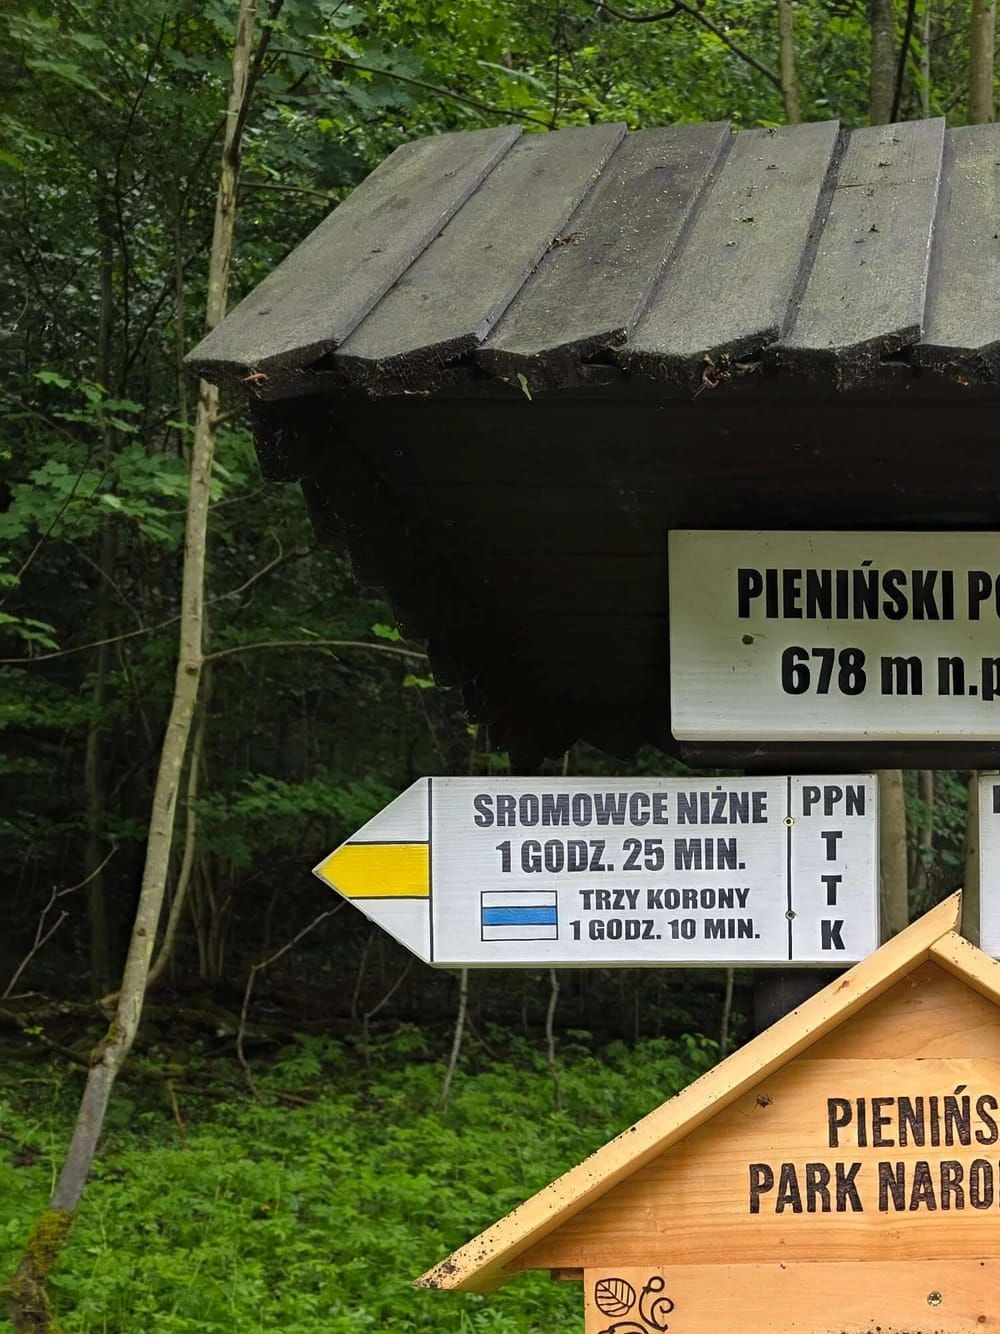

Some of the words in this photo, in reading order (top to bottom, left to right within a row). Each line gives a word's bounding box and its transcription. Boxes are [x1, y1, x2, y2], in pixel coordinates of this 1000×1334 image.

[738, 560, 954, 620] PIENIŃSKI
[782, 646, 866, 695] 678
[881, 656, 922, 695] m
[474, 792, 668, 827] SROMOWCE
[677, 786, 767, 824] NIŻNE
[803, 785, 865, 816] PPN
[496, 841, 511, 872] 1
[521, 839, 614, 873] GODZ.
[623, 838, 664, 871] 25
[675, 838, 745, 870] MIN.
[579, 889, 640, 910] TRZY
[647, 888, 750, 909] KORONY
[569, 920, 580, 940] 1
[589, 919, 661, 940] GODZ.
[668, 919, 696, 939] 10
[704, 919, 760, 939] MIN.
[749, 1163, 863, 1214] PARK
